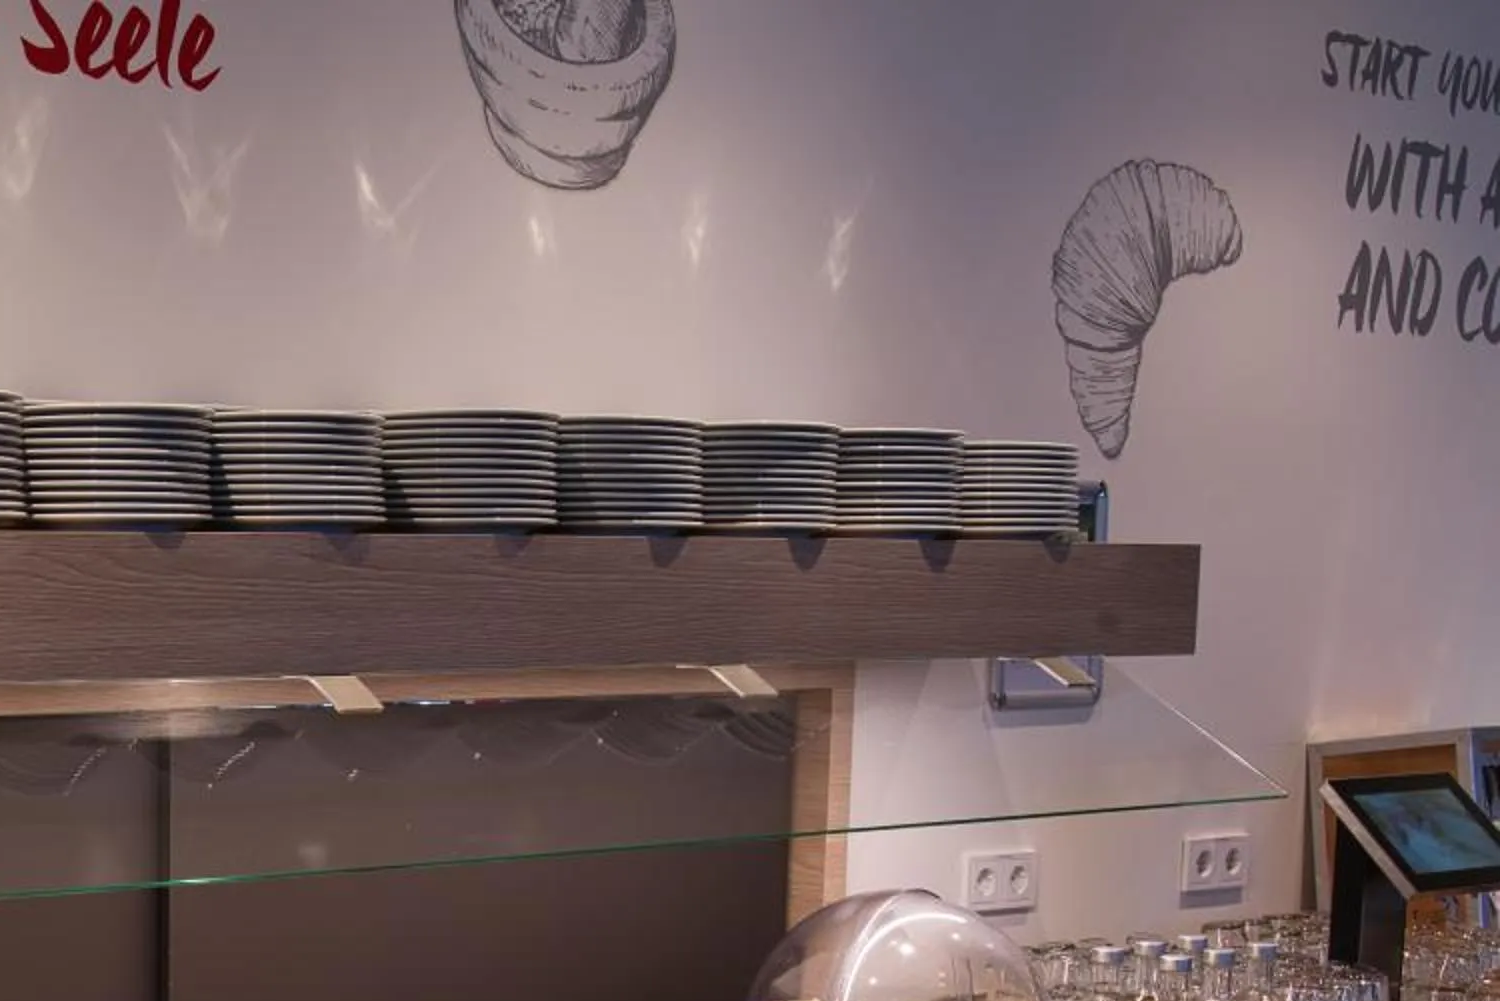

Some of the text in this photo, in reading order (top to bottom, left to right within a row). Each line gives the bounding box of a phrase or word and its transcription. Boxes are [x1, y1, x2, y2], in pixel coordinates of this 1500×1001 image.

[21, 0, 221, 91] Seele
[1321, 30, 1431, 100] START
[1346, 132, 1468, 223] WITH
[1338, 240, 1441, 336] AND
